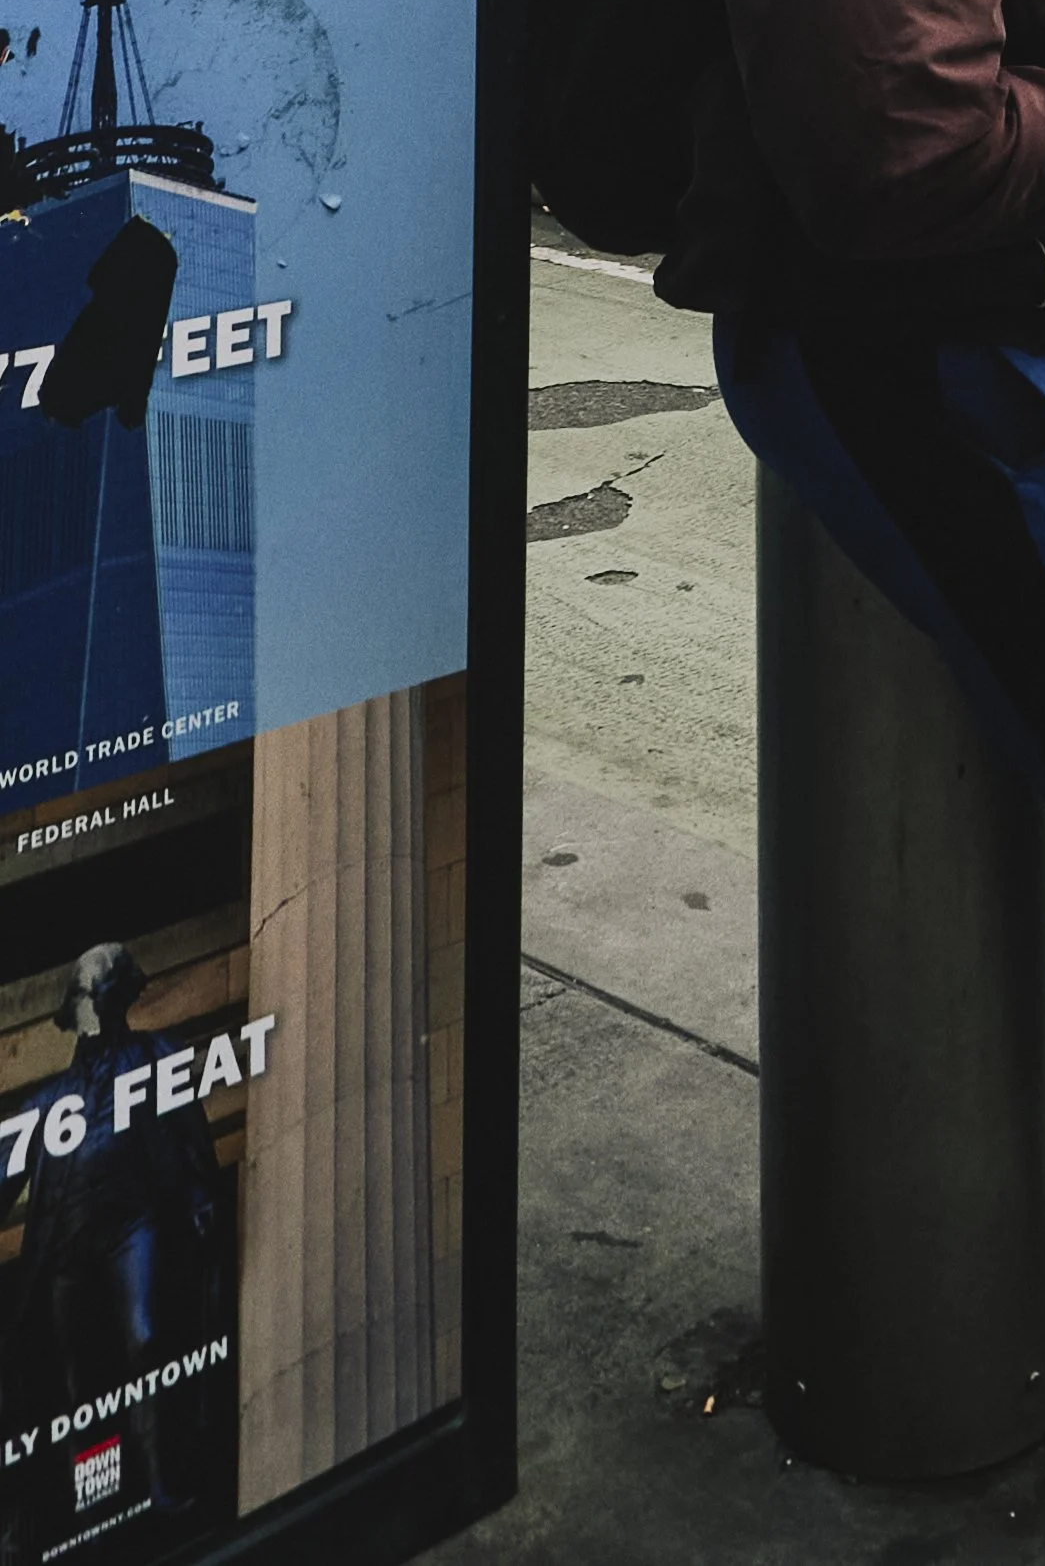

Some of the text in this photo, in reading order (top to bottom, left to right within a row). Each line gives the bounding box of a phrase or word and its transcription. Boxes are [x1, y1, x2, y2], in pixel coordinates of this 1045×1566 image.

[157, 299, 292, 378] EET
[0, 701, 239, 789] WORLD TRADE CENTER
[17, 788, 174, 854] FEDERAL HALL
[0, 1014, 275, 1178] 76 FEAT
[51, 1335, 228, 1444] DOWNTOWN
[75, 1443, 120, 1482] DOWN
[75, 1464, 120, 1501] TOWN
